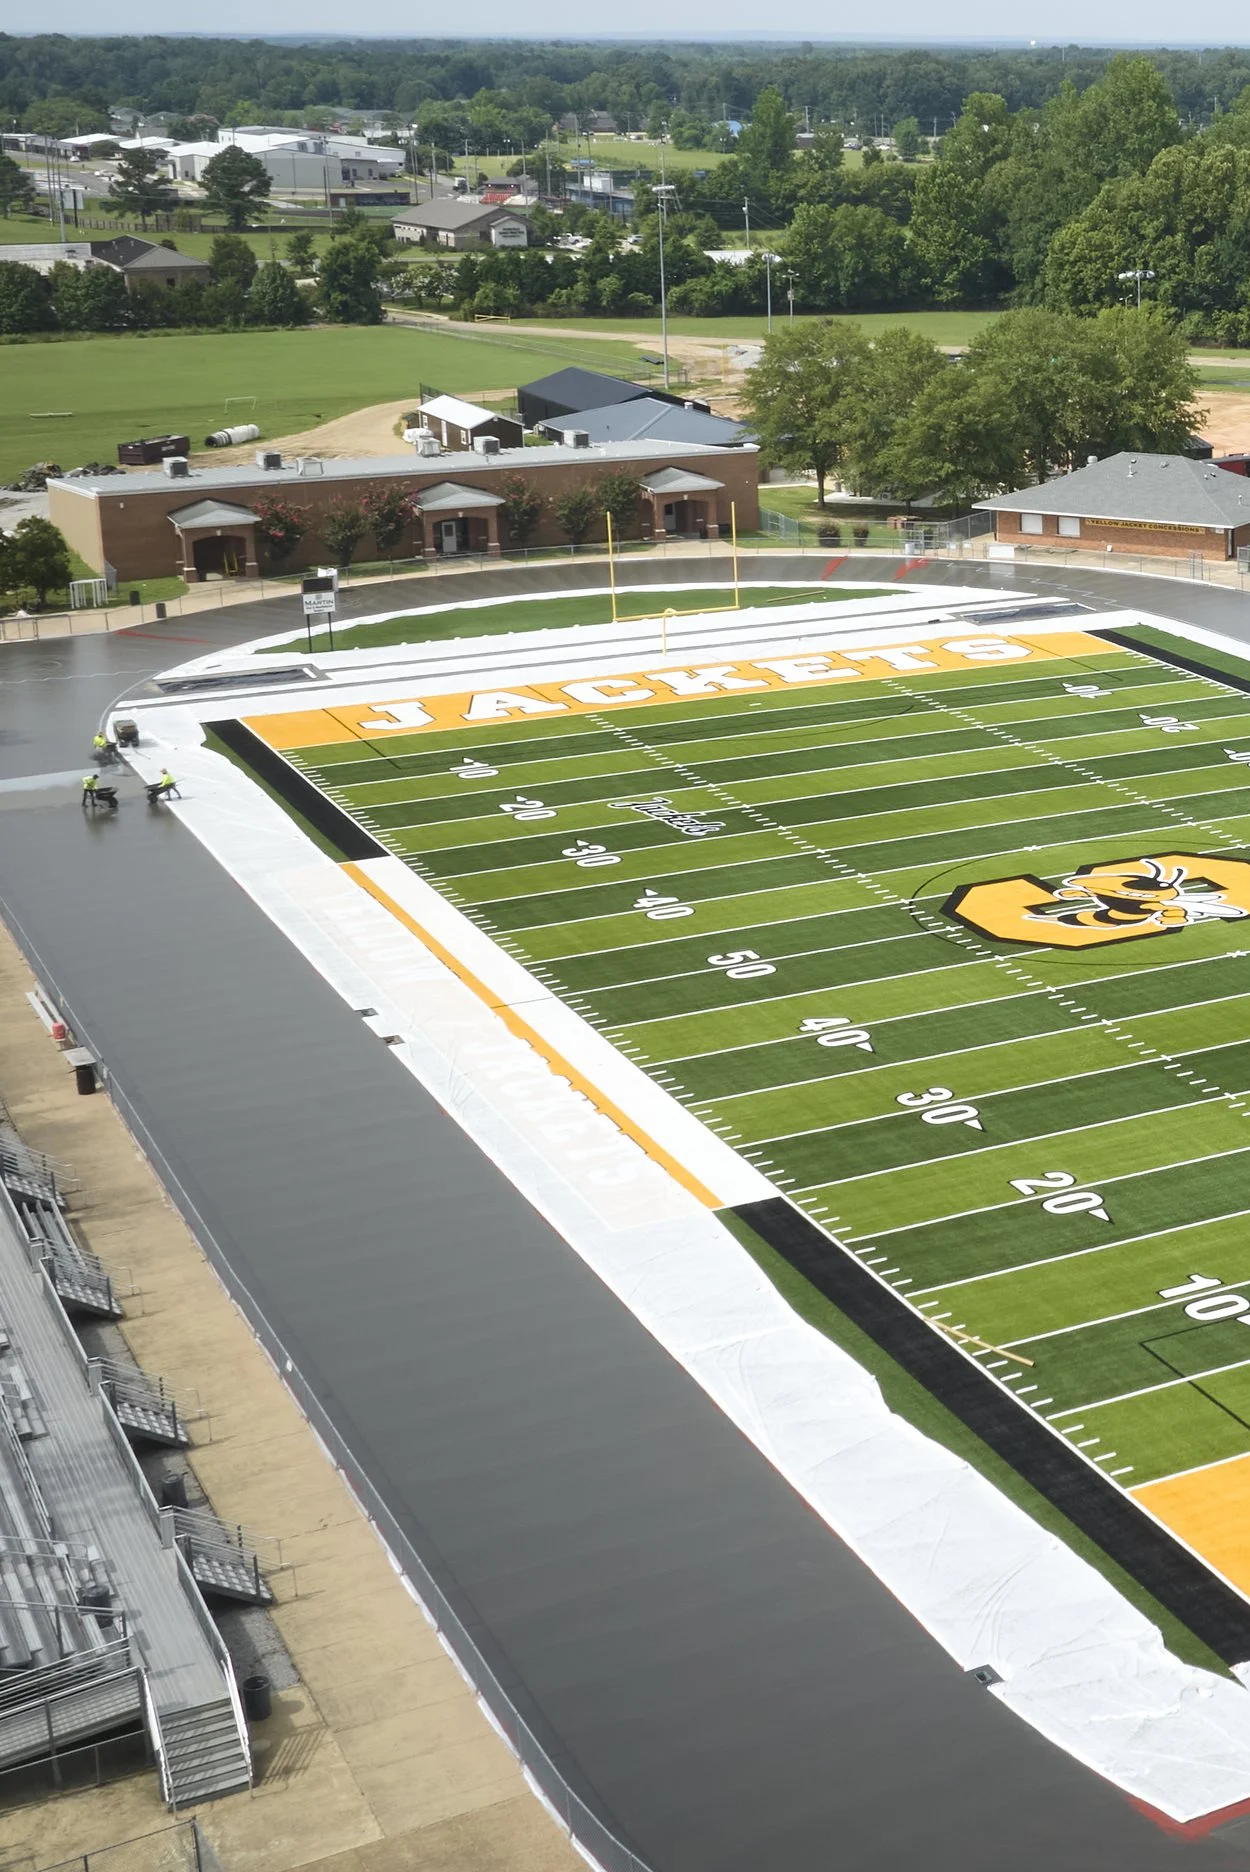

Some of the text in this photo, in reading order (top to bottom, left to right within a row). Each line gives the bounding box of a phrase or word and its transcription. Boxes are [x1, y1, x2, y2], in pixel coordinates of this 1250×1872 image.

[1149, 524, 1200, 533] CONCESSIONS
[359, 636, 1034, 732] JACKETS
[1066, 684, 1112, 699] 10
[1143, 716, 1199, 733] 20
[450, 762, 499, 779] 10
[501, 801, 557, 821] 20
[562, 845, 621, 867] 30
[633, 897, 694, 920] 40
[707, 951, 777, 979] 50
[799, 1017, 871, 1047] 40
[897, 1088, 979, 1125] 30
[1009, 1172, 1103, 1215] 20
[1158, 1274, 1250, 1322] 10
